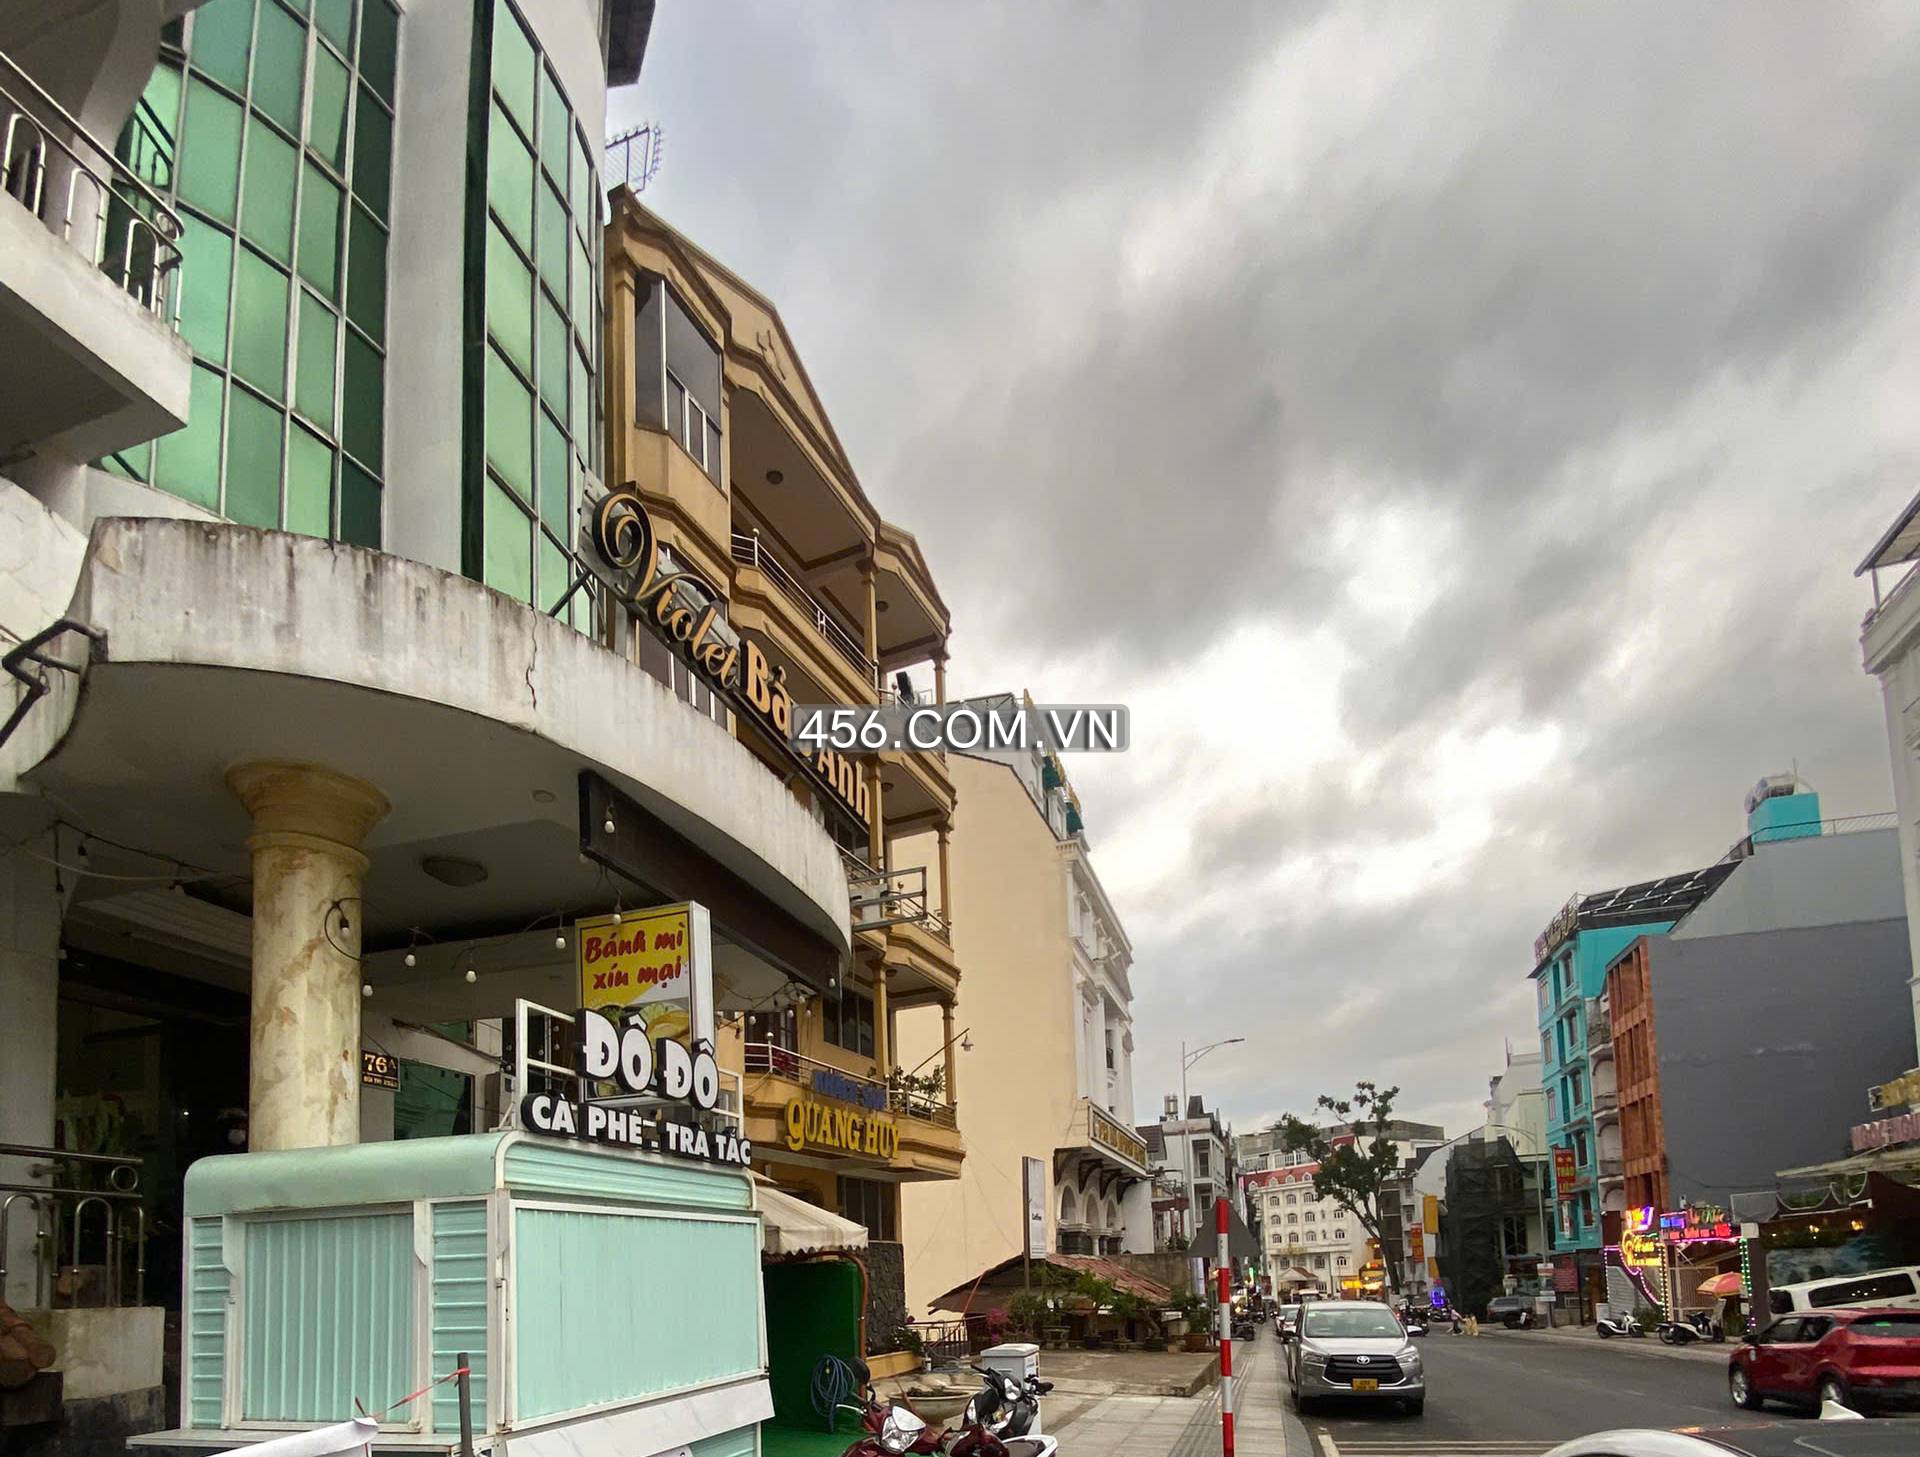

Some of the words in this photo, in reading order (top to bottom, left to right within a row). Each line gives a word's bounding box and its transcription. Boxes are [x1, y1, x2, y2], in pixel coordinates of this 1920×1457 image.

[599, 492, 739, 690] Violet
[817, 738, 871, 826] Anh
[584, 930, 646, 963] Bánh
[654, 921, 686, 950] mì
[637, 955, 682, 989] mại
[581, 1010, 653, 1092] ĐÔ
[662, 1038, 719, 1109] ĐÔ
[531, 1093, 576, 1134] CÀ
[587, 1110, 643, 1146] PHÊ
[665, 1121, 711, 1159] TRÀ
[715, 1127, 752, 1166] TẮC
[864, 1115, 899, 1159] HUY
